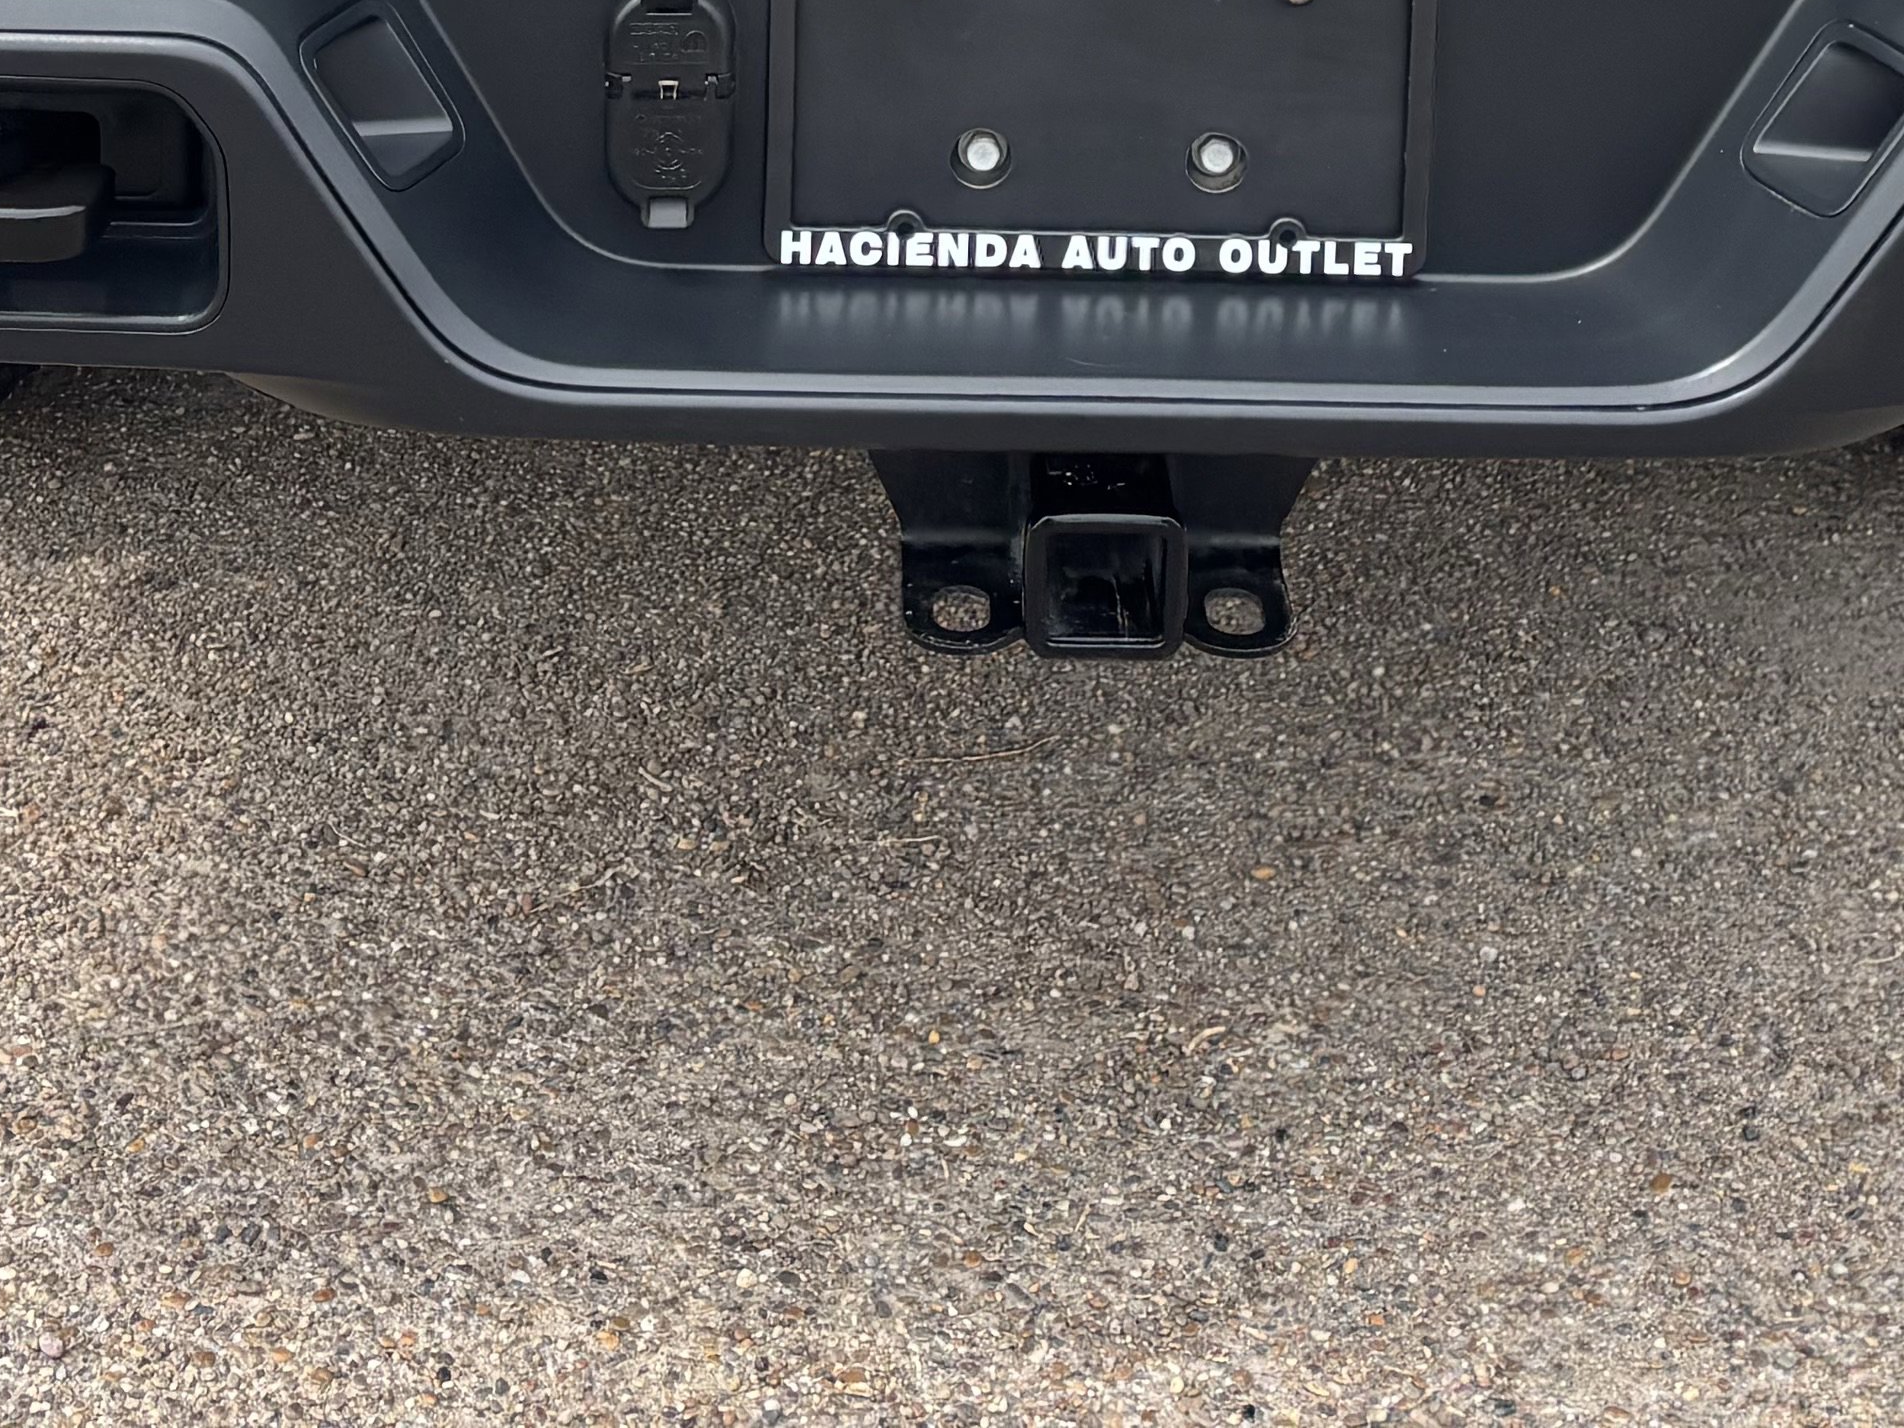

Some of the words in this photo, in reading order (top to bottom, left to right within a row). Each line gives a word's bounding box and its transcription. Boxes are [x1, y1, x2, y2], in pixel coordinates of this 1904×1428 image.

[779, 230, 1042, 270] HACIENDA
[1061, 234, 1197, 274] AUTO
[1218, 238, 1415, 279] OUTLET
